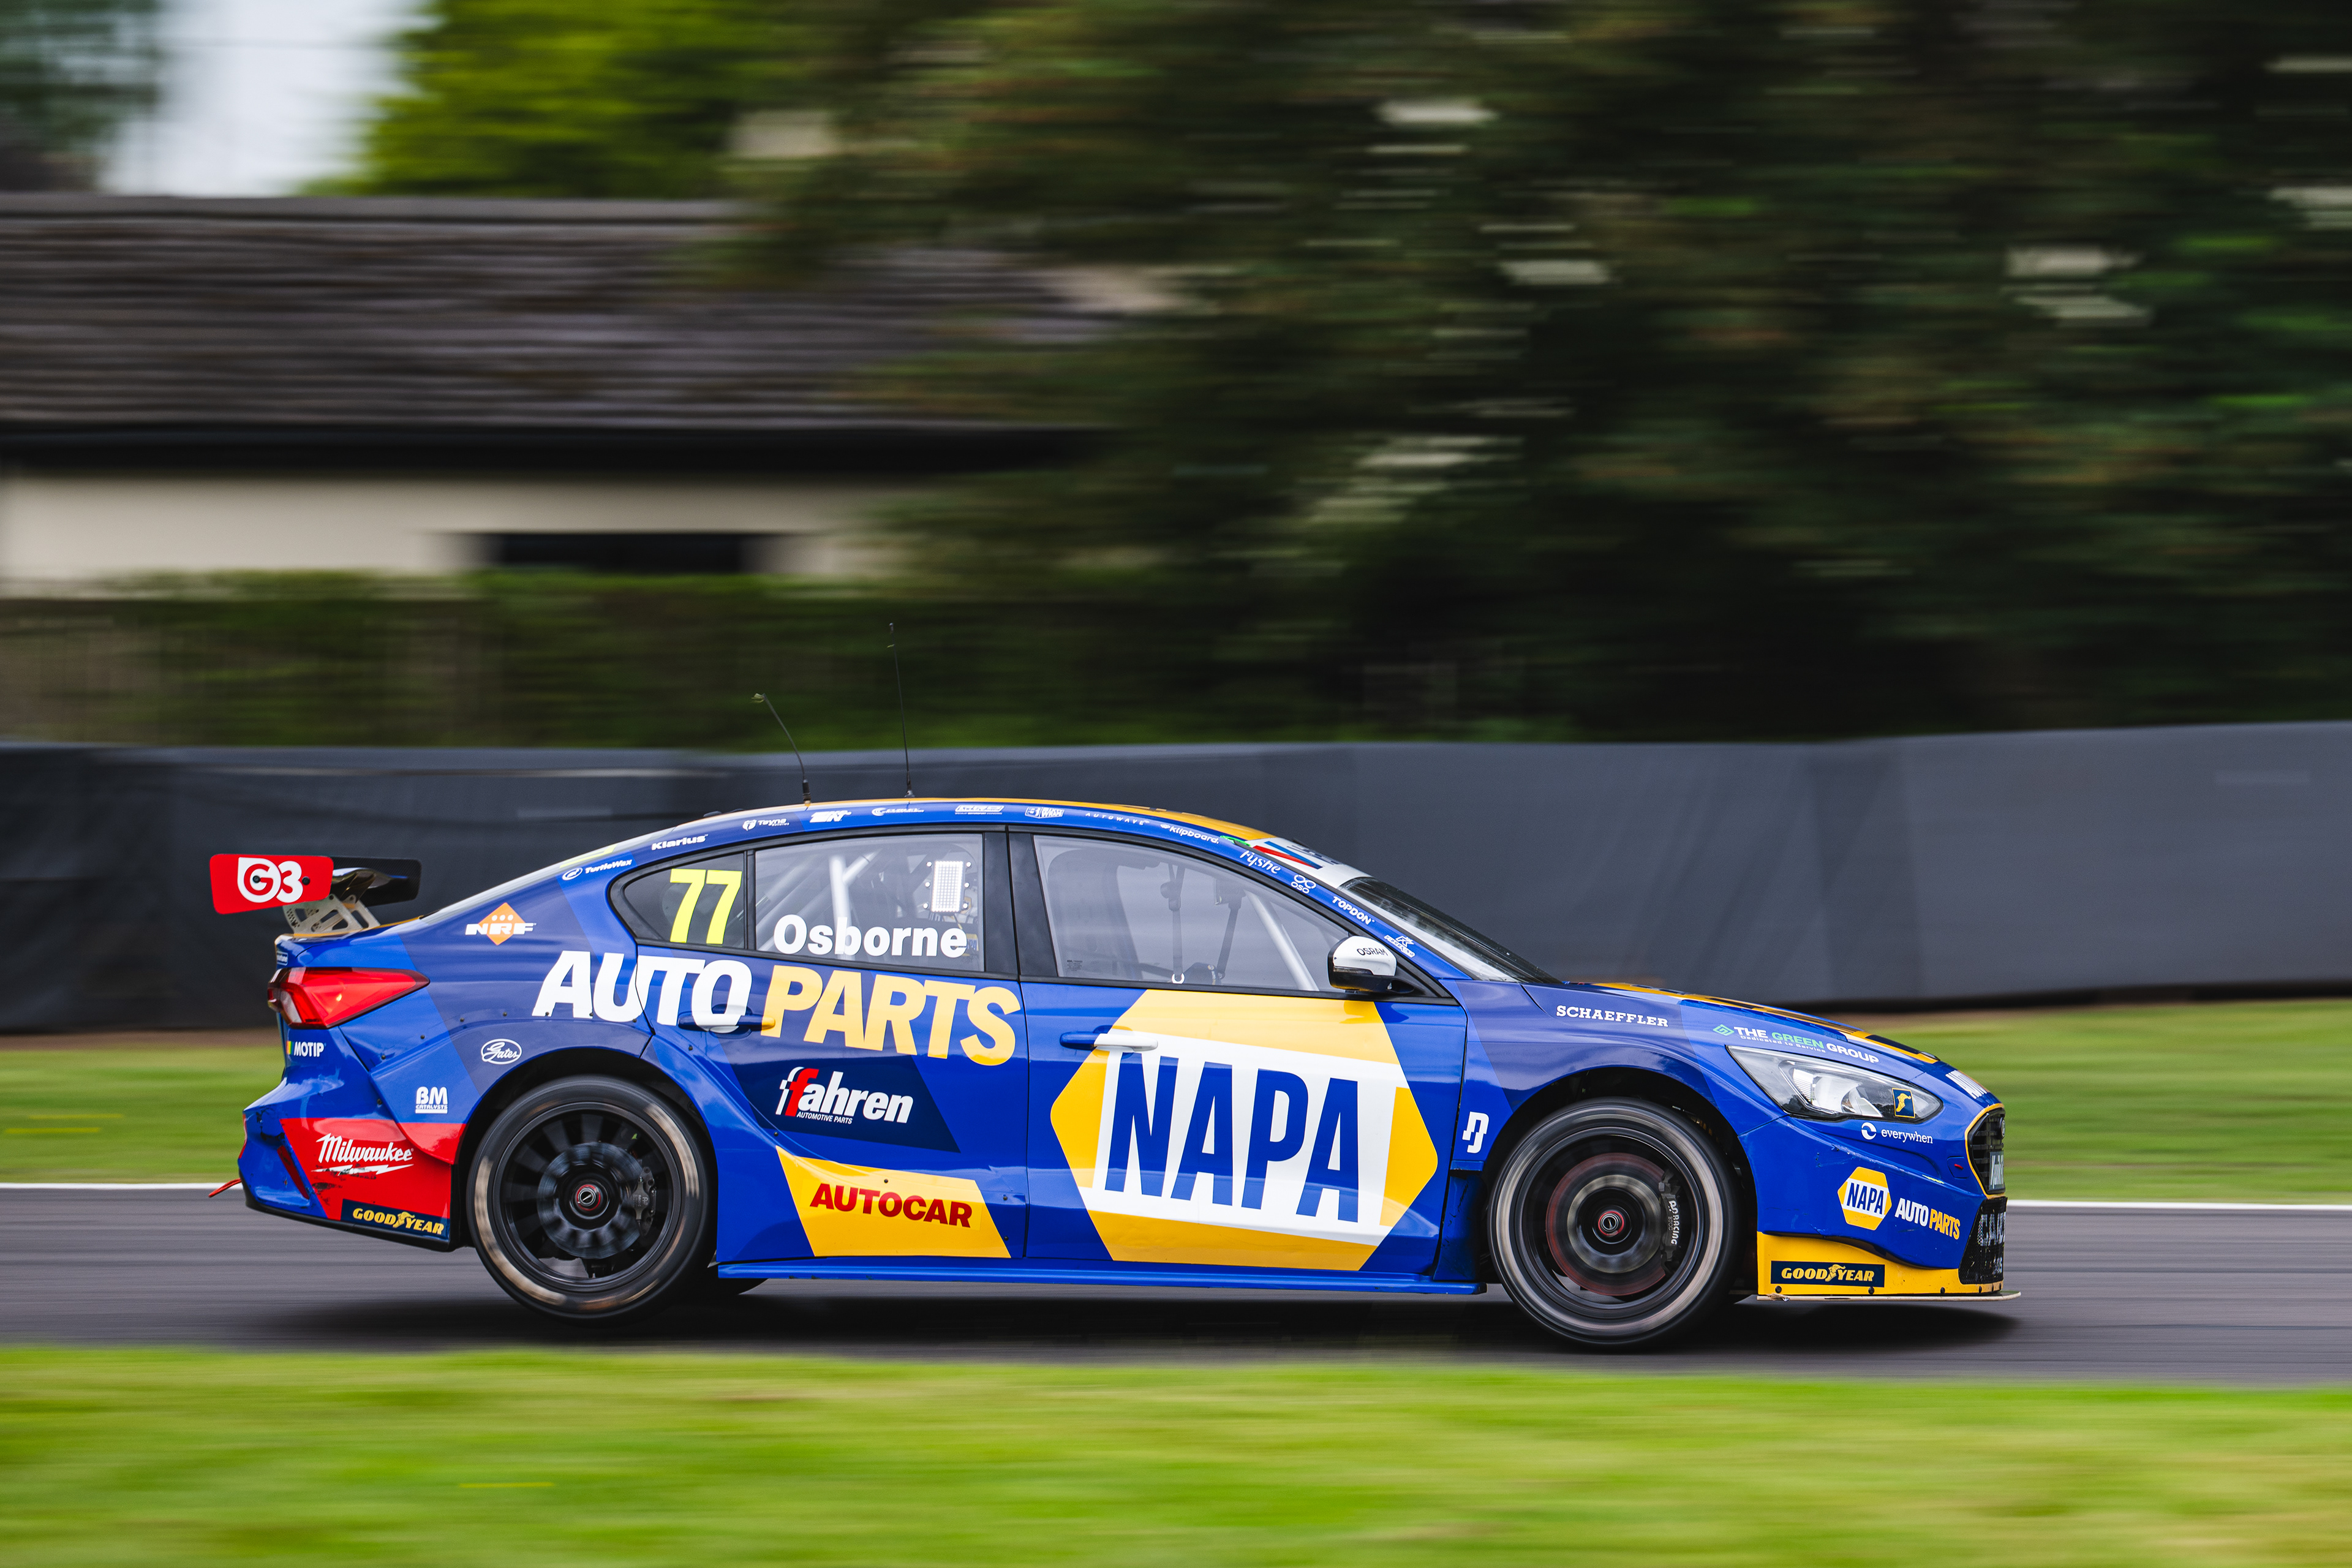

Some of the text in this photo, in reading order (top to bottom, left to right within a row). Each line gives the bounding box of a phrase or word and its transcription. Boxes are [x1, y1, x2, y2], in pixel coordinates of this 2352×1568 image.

[237, 857, 303, 903] G3
[1291, 881, 1310, 894] OSO
[669, 869, 742, 944] 77
[1332, 896, 1371, 925] TOPDON
[465, 923, 533, 935] NRF
[773, 914, 967, 959] Osborne
[1357, 948, 1388, 956] OSRAM
[532, 950, 1020, 1067] AUTO PARTS
[1556, 1005, 1668, 1027] SCHAEFFLER
[294, 1041, 324, 1057] MOTIP
[483, 1041, 519, 1061] Gates
[1734, 1027, 1879, 1064] THE GREEN GROUP
[416, 1086, 448, 1104] BM
[775, 1066, 914, 1124] fahren
[796, 1111, 853, 1125] AUTOMOTIVE PARTS
[316, 1133, 413, 1163] Milwaukee
[1104, 1052, 1359, 1223] NAPA
[1881, 1128, 1933, 1144] everywhen
[810, 1183, 973, 1228] AUTOCAR
[1847, 1182, 1885, 1215] NAPA
[353, 1207, 444, 1235] GOODYEAR
[1671, 1215, 1679, 1245] RACING
[1894, 1198, 1961, 1240] AUTO PARTS
[1781, 1264, 1874, 1282] GOODYEAR
